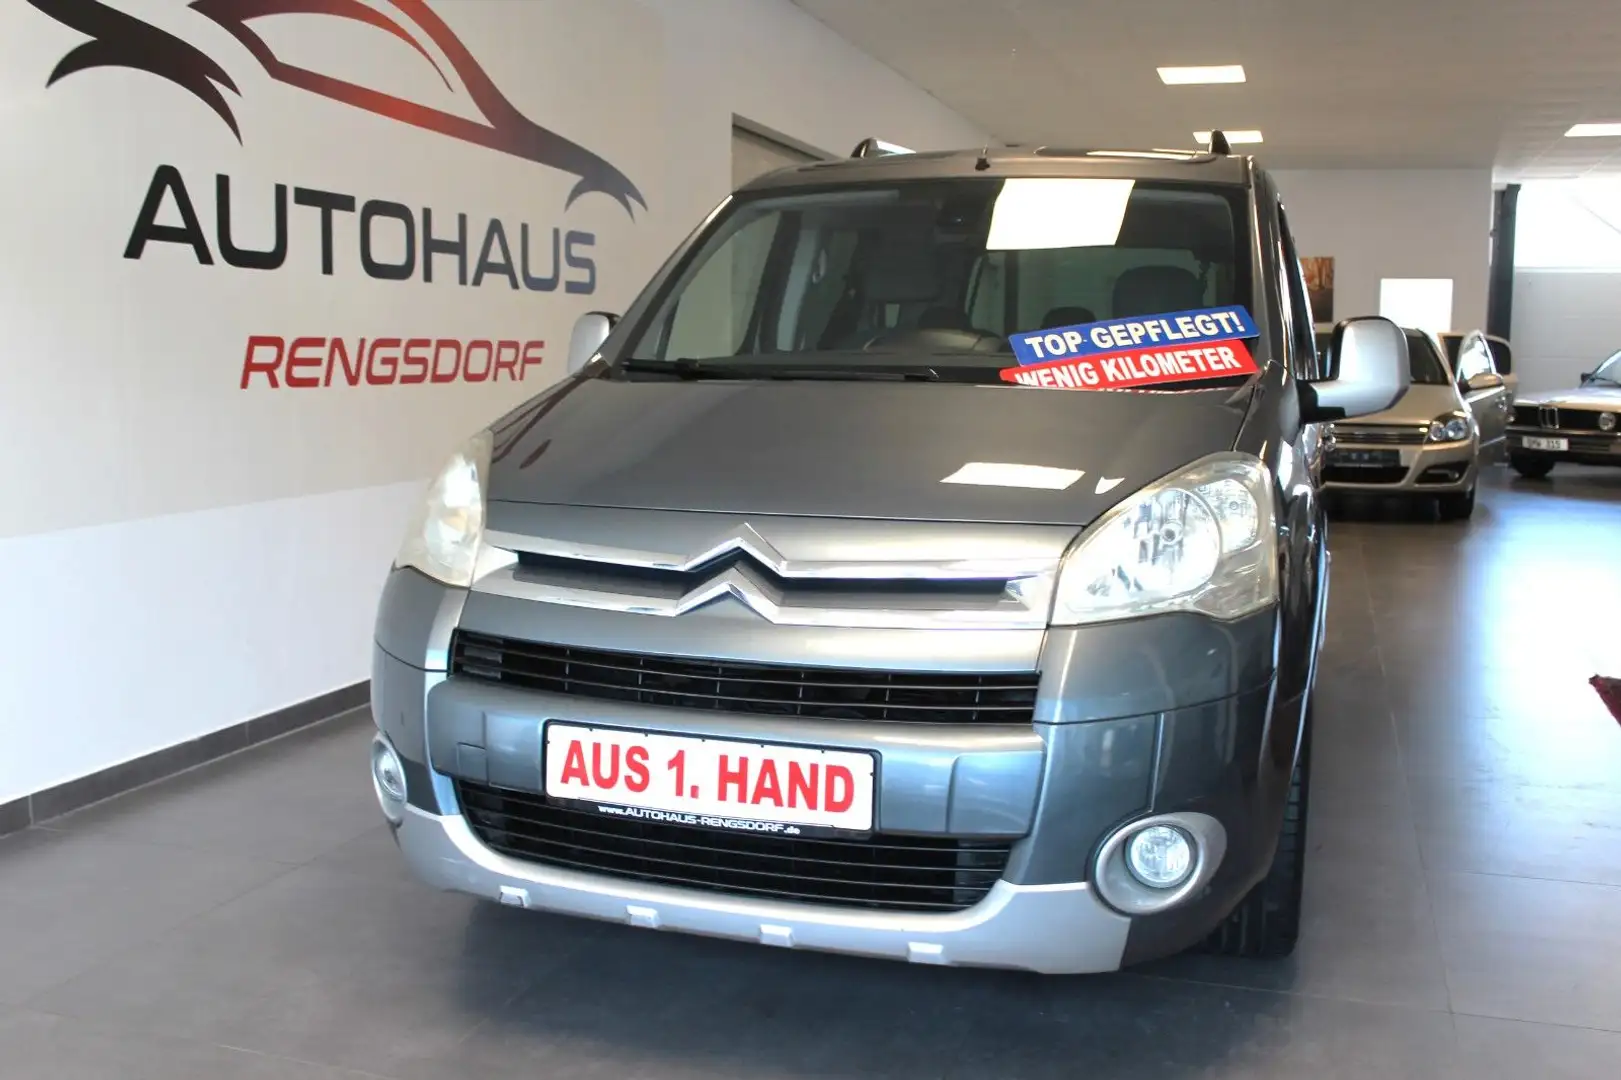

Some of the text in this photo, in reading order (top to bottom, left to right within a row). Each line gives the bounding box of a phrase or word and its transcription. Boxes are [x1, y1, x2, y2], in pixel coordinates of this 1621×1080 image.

[123, 163, 596, 295] AUTOHAUS
[1025, 311, 1245, 358] TOP GEPFLEGT!
[240, 335, 545, 389] RENGSDORF
[1014, 346, 1241, 388] WENIG KILOMETER
[561, 739, 855, 813] AUS 1. HAND
[598, 805, 800, 835] www.AUTOHAUS-RENGSDORF.de
